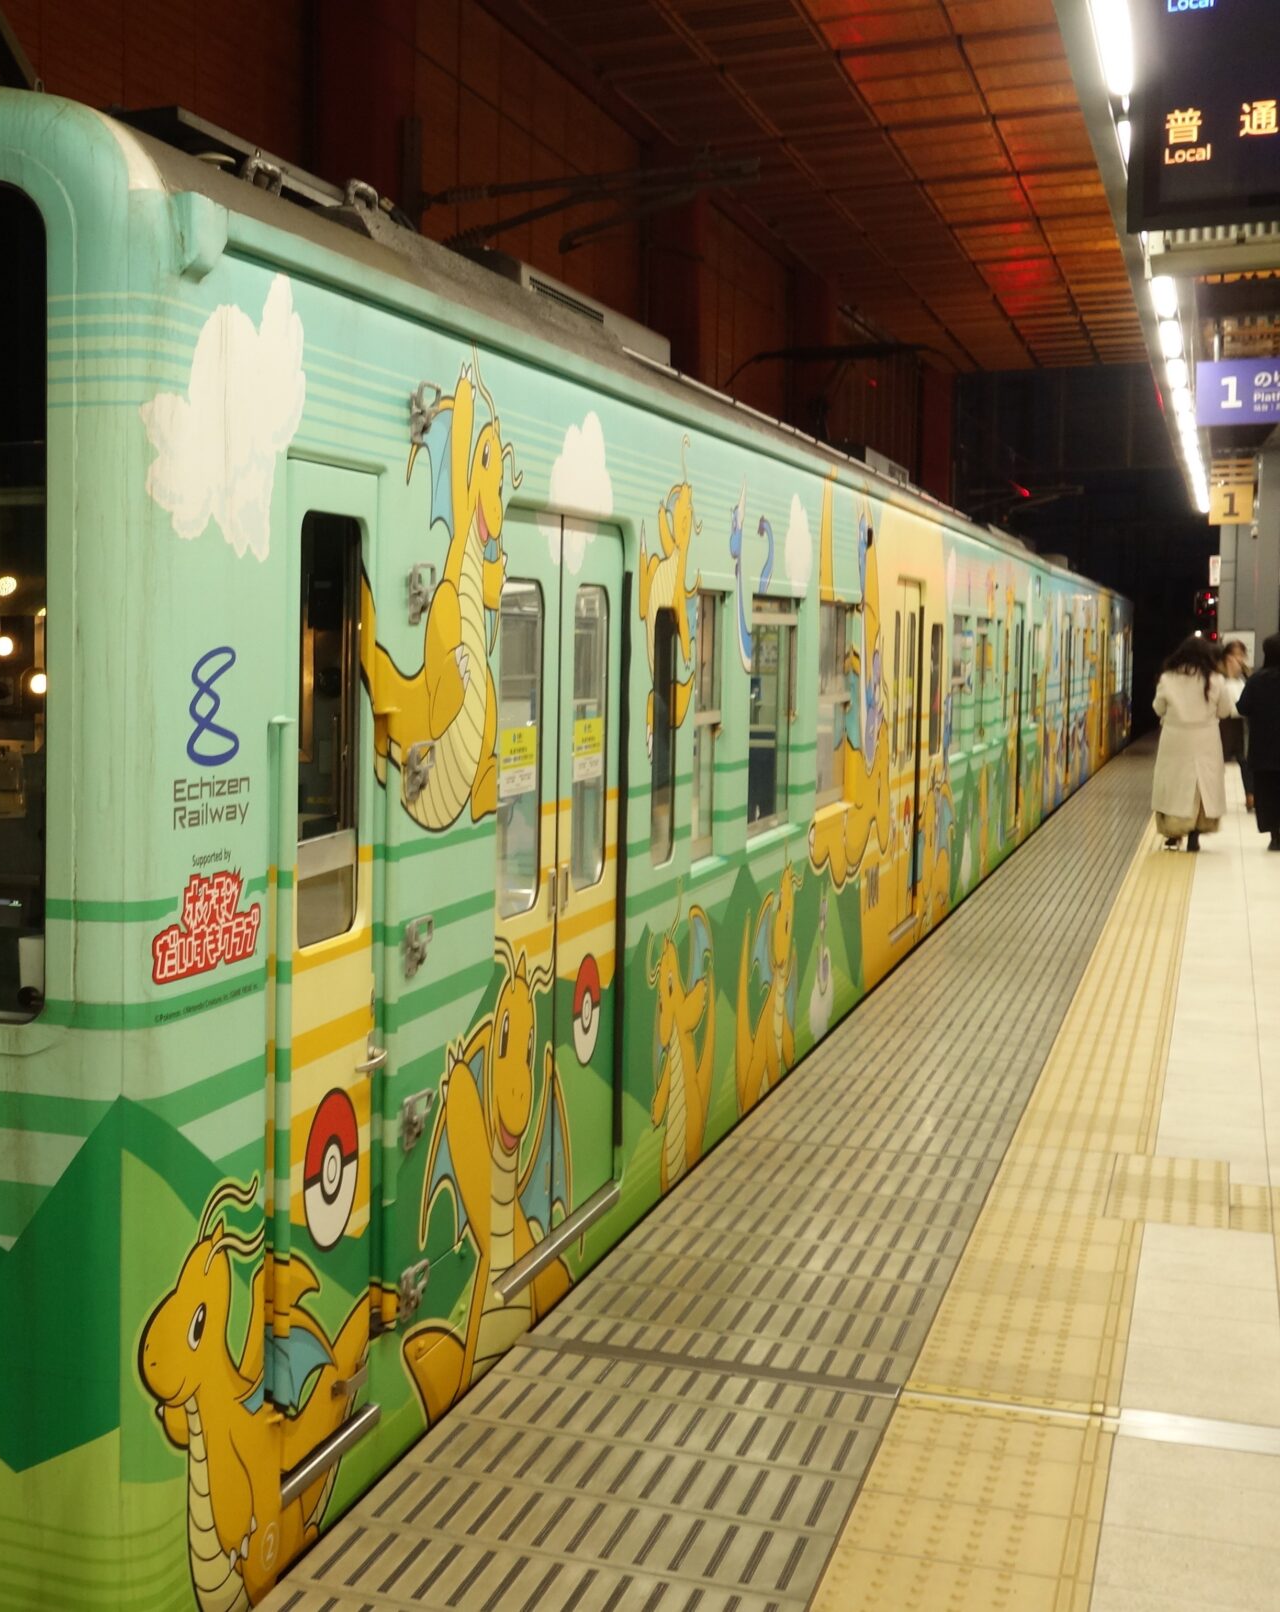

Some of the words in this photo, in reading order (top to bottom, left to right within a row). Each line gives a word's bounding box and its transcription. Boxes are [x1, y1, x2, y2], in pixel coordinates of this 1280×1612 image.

[1165, 143, 1211, 164] Local
[1221, 375, 1243, 409] 1
[1222, 493, 1240, 517] 1
[173, 775, 250, 802] Echizen
[173, 802, 250, 830] Railway
[192, 849, 223, 868] Supported
[223, 848, 232, 863] by
[183, 876, 239, 929] ポケモン
[156, 907, 260, 979] だいすきクラブ
